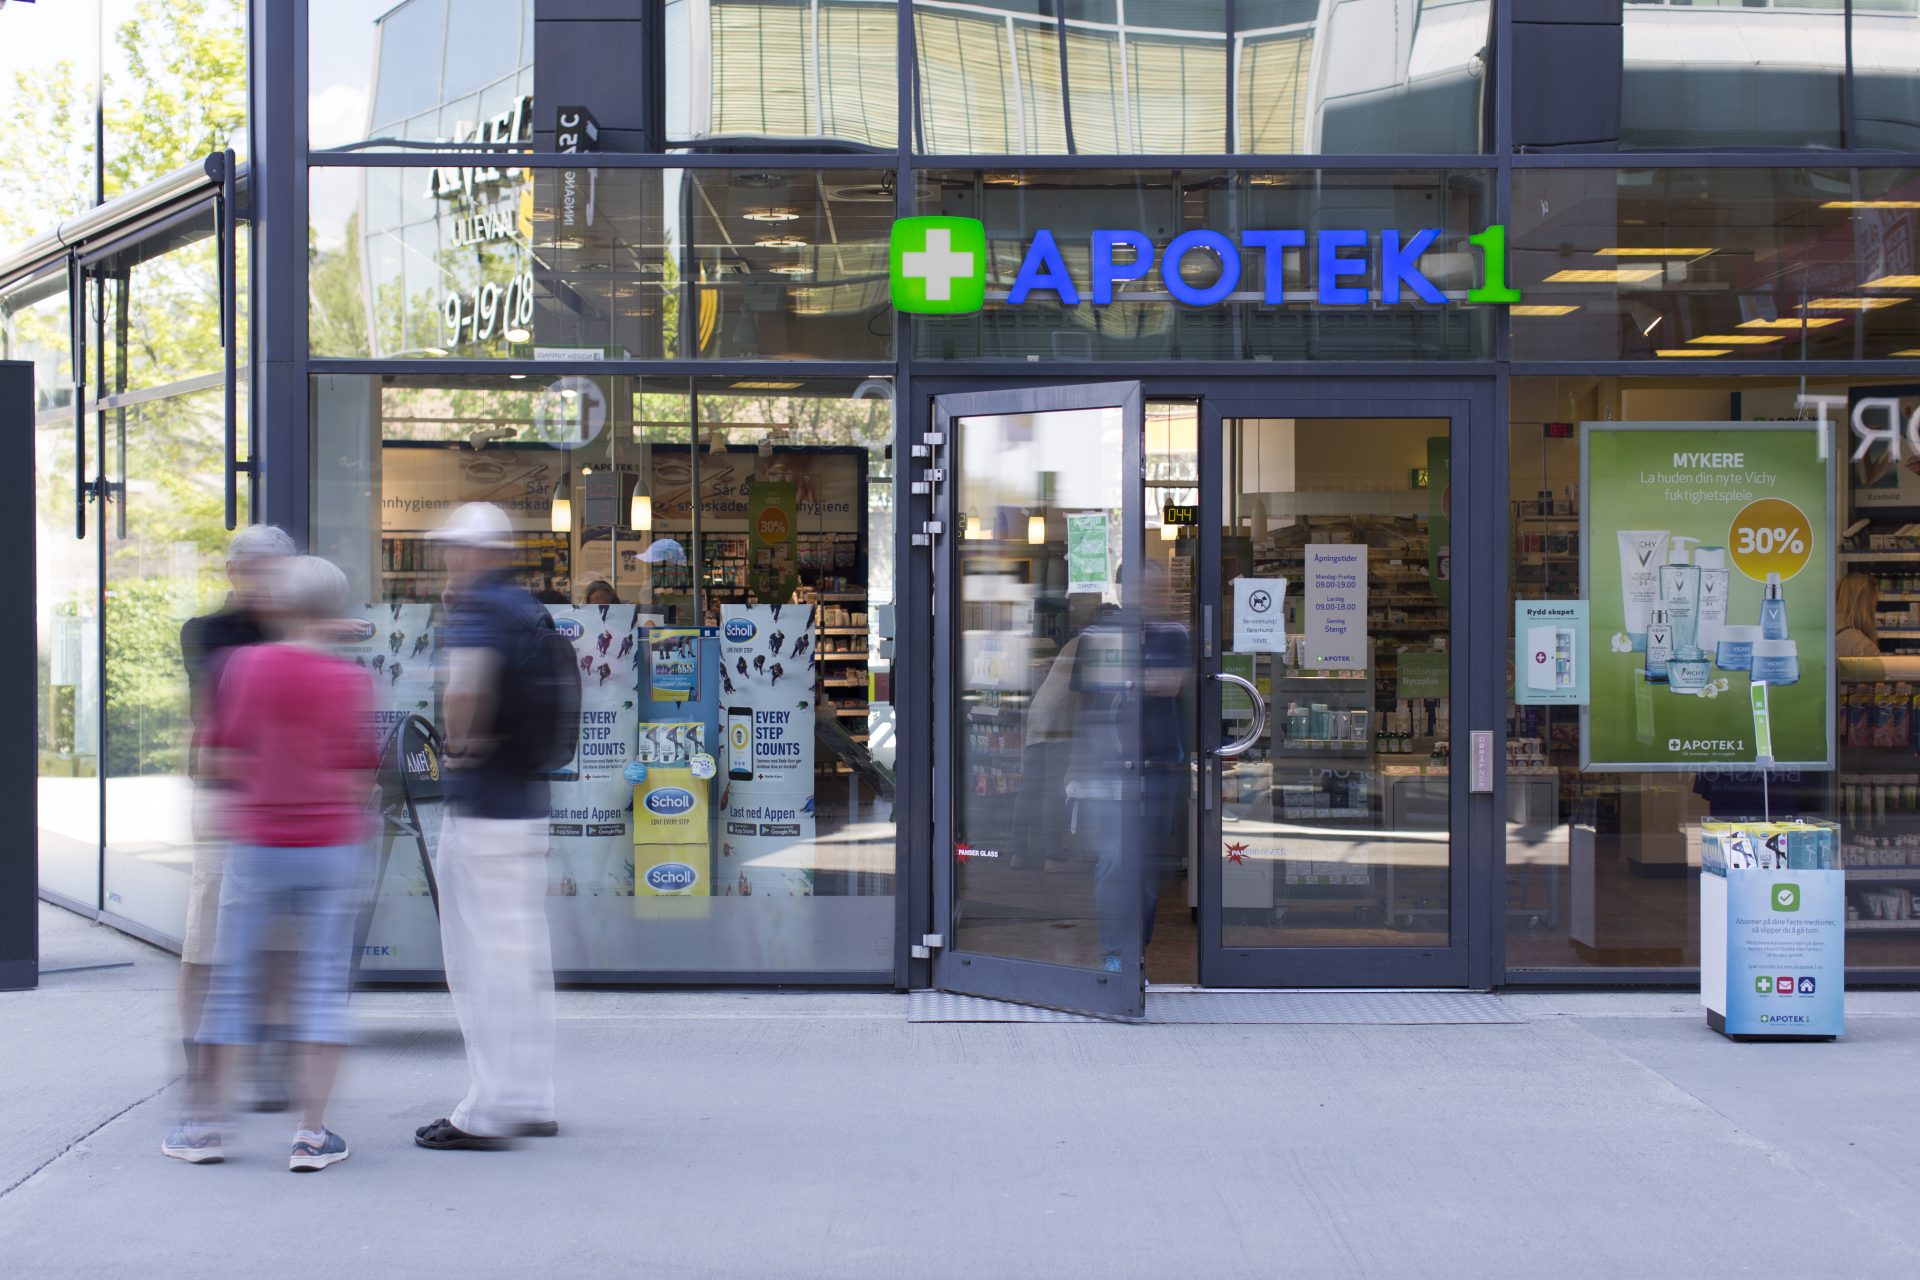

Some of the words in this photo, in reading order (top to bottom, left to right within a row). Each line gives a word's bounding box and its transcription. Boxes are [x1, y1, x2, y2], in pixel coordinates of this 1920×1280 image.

[1006, 228, 1452, 307] APOTEK
[1468, 224, 1522, 303] 1
[1673, 453, 1745, 469] MYKERE
[1640, 472, 1655, 484] La
[1658, 471, 1693, 484] huden
[1696, 472, 1713, 484] din
[1716, 473, 1742, 487] nyte
[1745, 472, 1777, 487] Vichy
[1664, 489, 1753, 504] fuktighetspleie
[1168, 508, 1192, 521] 044
[760, 520, 785, 533] 30%
[1738, 527, 1804, 554] 30%
[1314, 553, 1358, 564] Åpningstider
[1315, 581, 1356, 589] 09.00-19.00
[1315, 603, 1356, 611] 09.00-18.00
[1527, 609, 1547, 617] Rydd
[1548, 609, 1575, 617] skapet
[726, 624, 753, 637] Scholl
[1324, 626, 1347, 634] Stengt
[583, 711, 617, 724] EVERY
[755, 711, 791, 724] EVERY
[583, 727, 611, 740] STEP
[755, 727, 784, 740] STEP
[583, 743, 626, 756] COUNTS
[755, 743, 801, 756] COUNTS
[1682, 740, 1735, 750] APOTEK
[1737, 740, 1744, 750] 1
[651, 795, 689, 808] Scholl
[550, 807, 568, 819] Last
[570, 807, 588, 819] ned
[592, 807, 621, 822] Appen
[730, 805, 745, 818] Last
[746, 807, 761, 818] ned
[764, 807, 795, 822] Appen
[958, 849, 980, 857] PANSER
[980, 850, 999, 858] GLASS
[652, 871, 691, 883] Scholl
[1769, 1015, 1804, 1023] APOTEK
